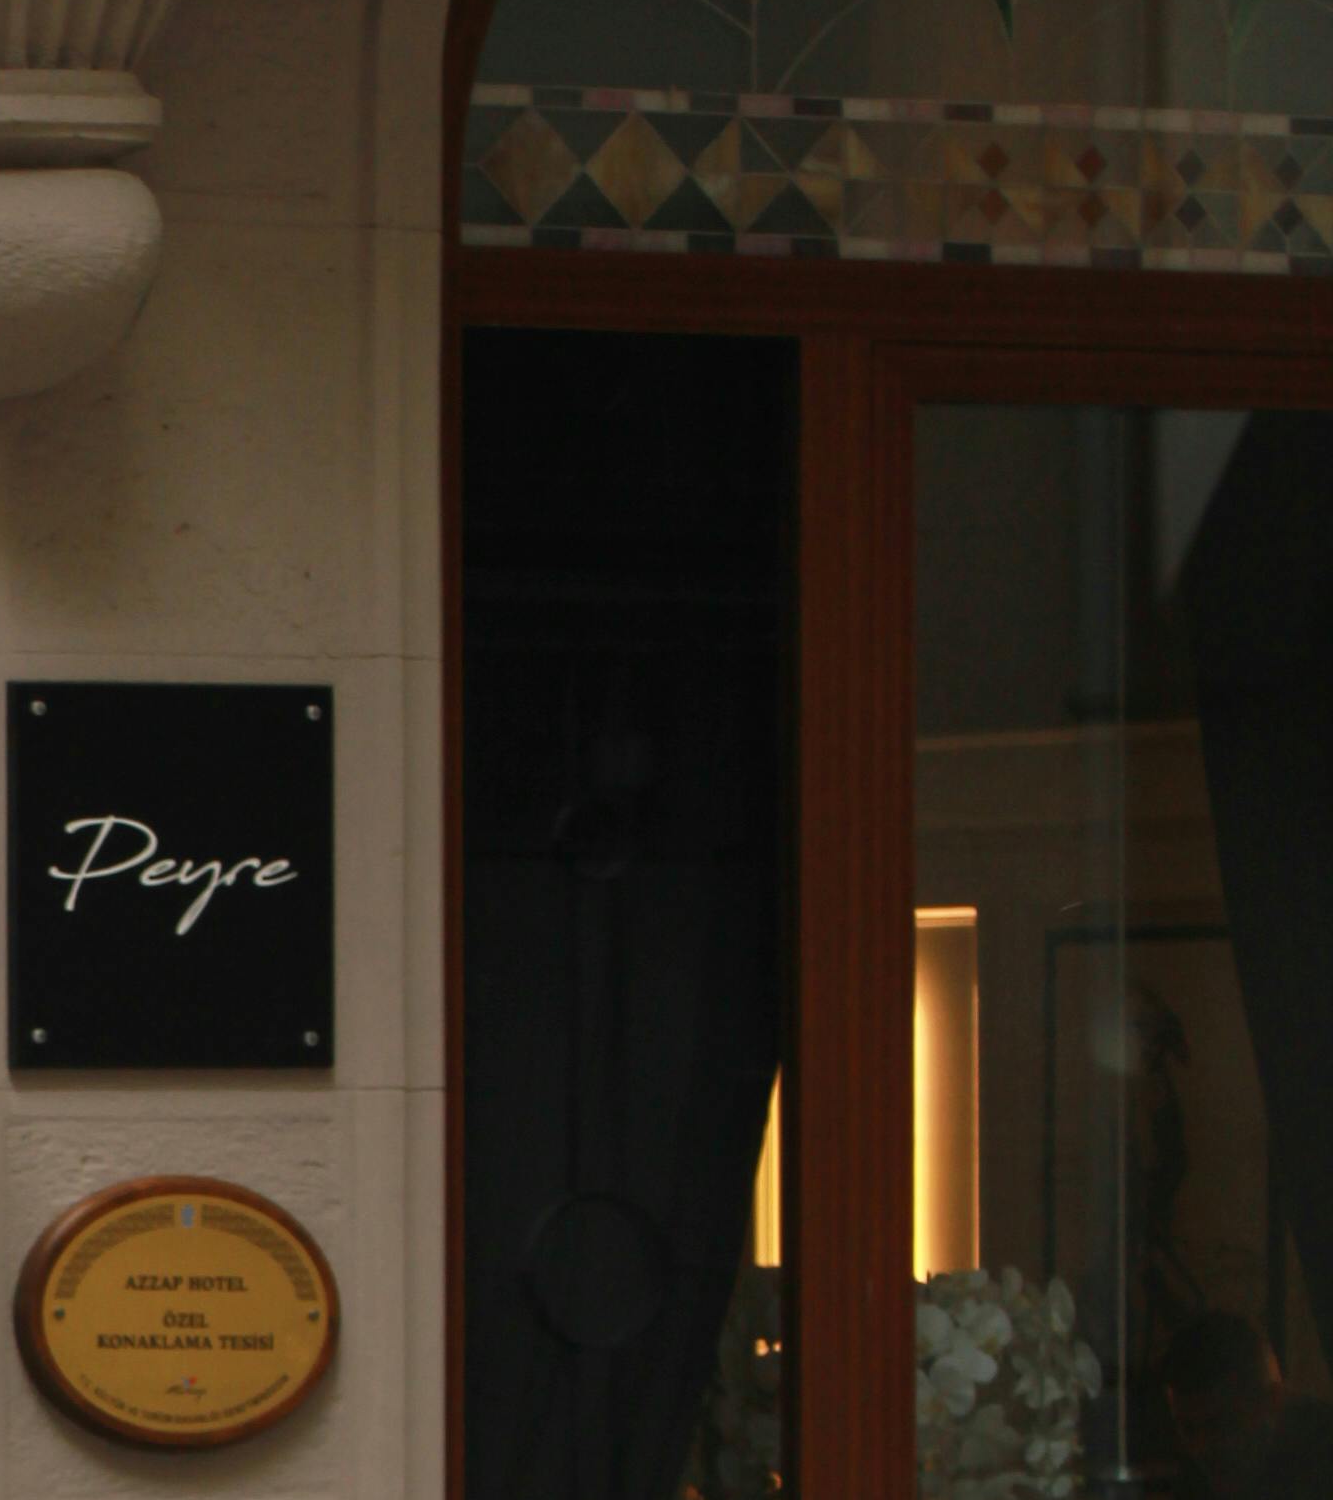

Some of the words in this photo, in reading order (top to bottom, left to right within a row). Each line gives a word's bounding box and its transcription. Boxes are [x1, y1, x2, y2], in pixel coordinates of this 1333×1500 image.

[48, 815, 298, 936] Peyre
[125, 1274, 183, 1291] AZZAP
[188, 1275, 247, 1292] HOTEL
[162, 1309, 209, 1328] ÖZEL
[97, 1333, 213, 1350] KONAKLAMA
